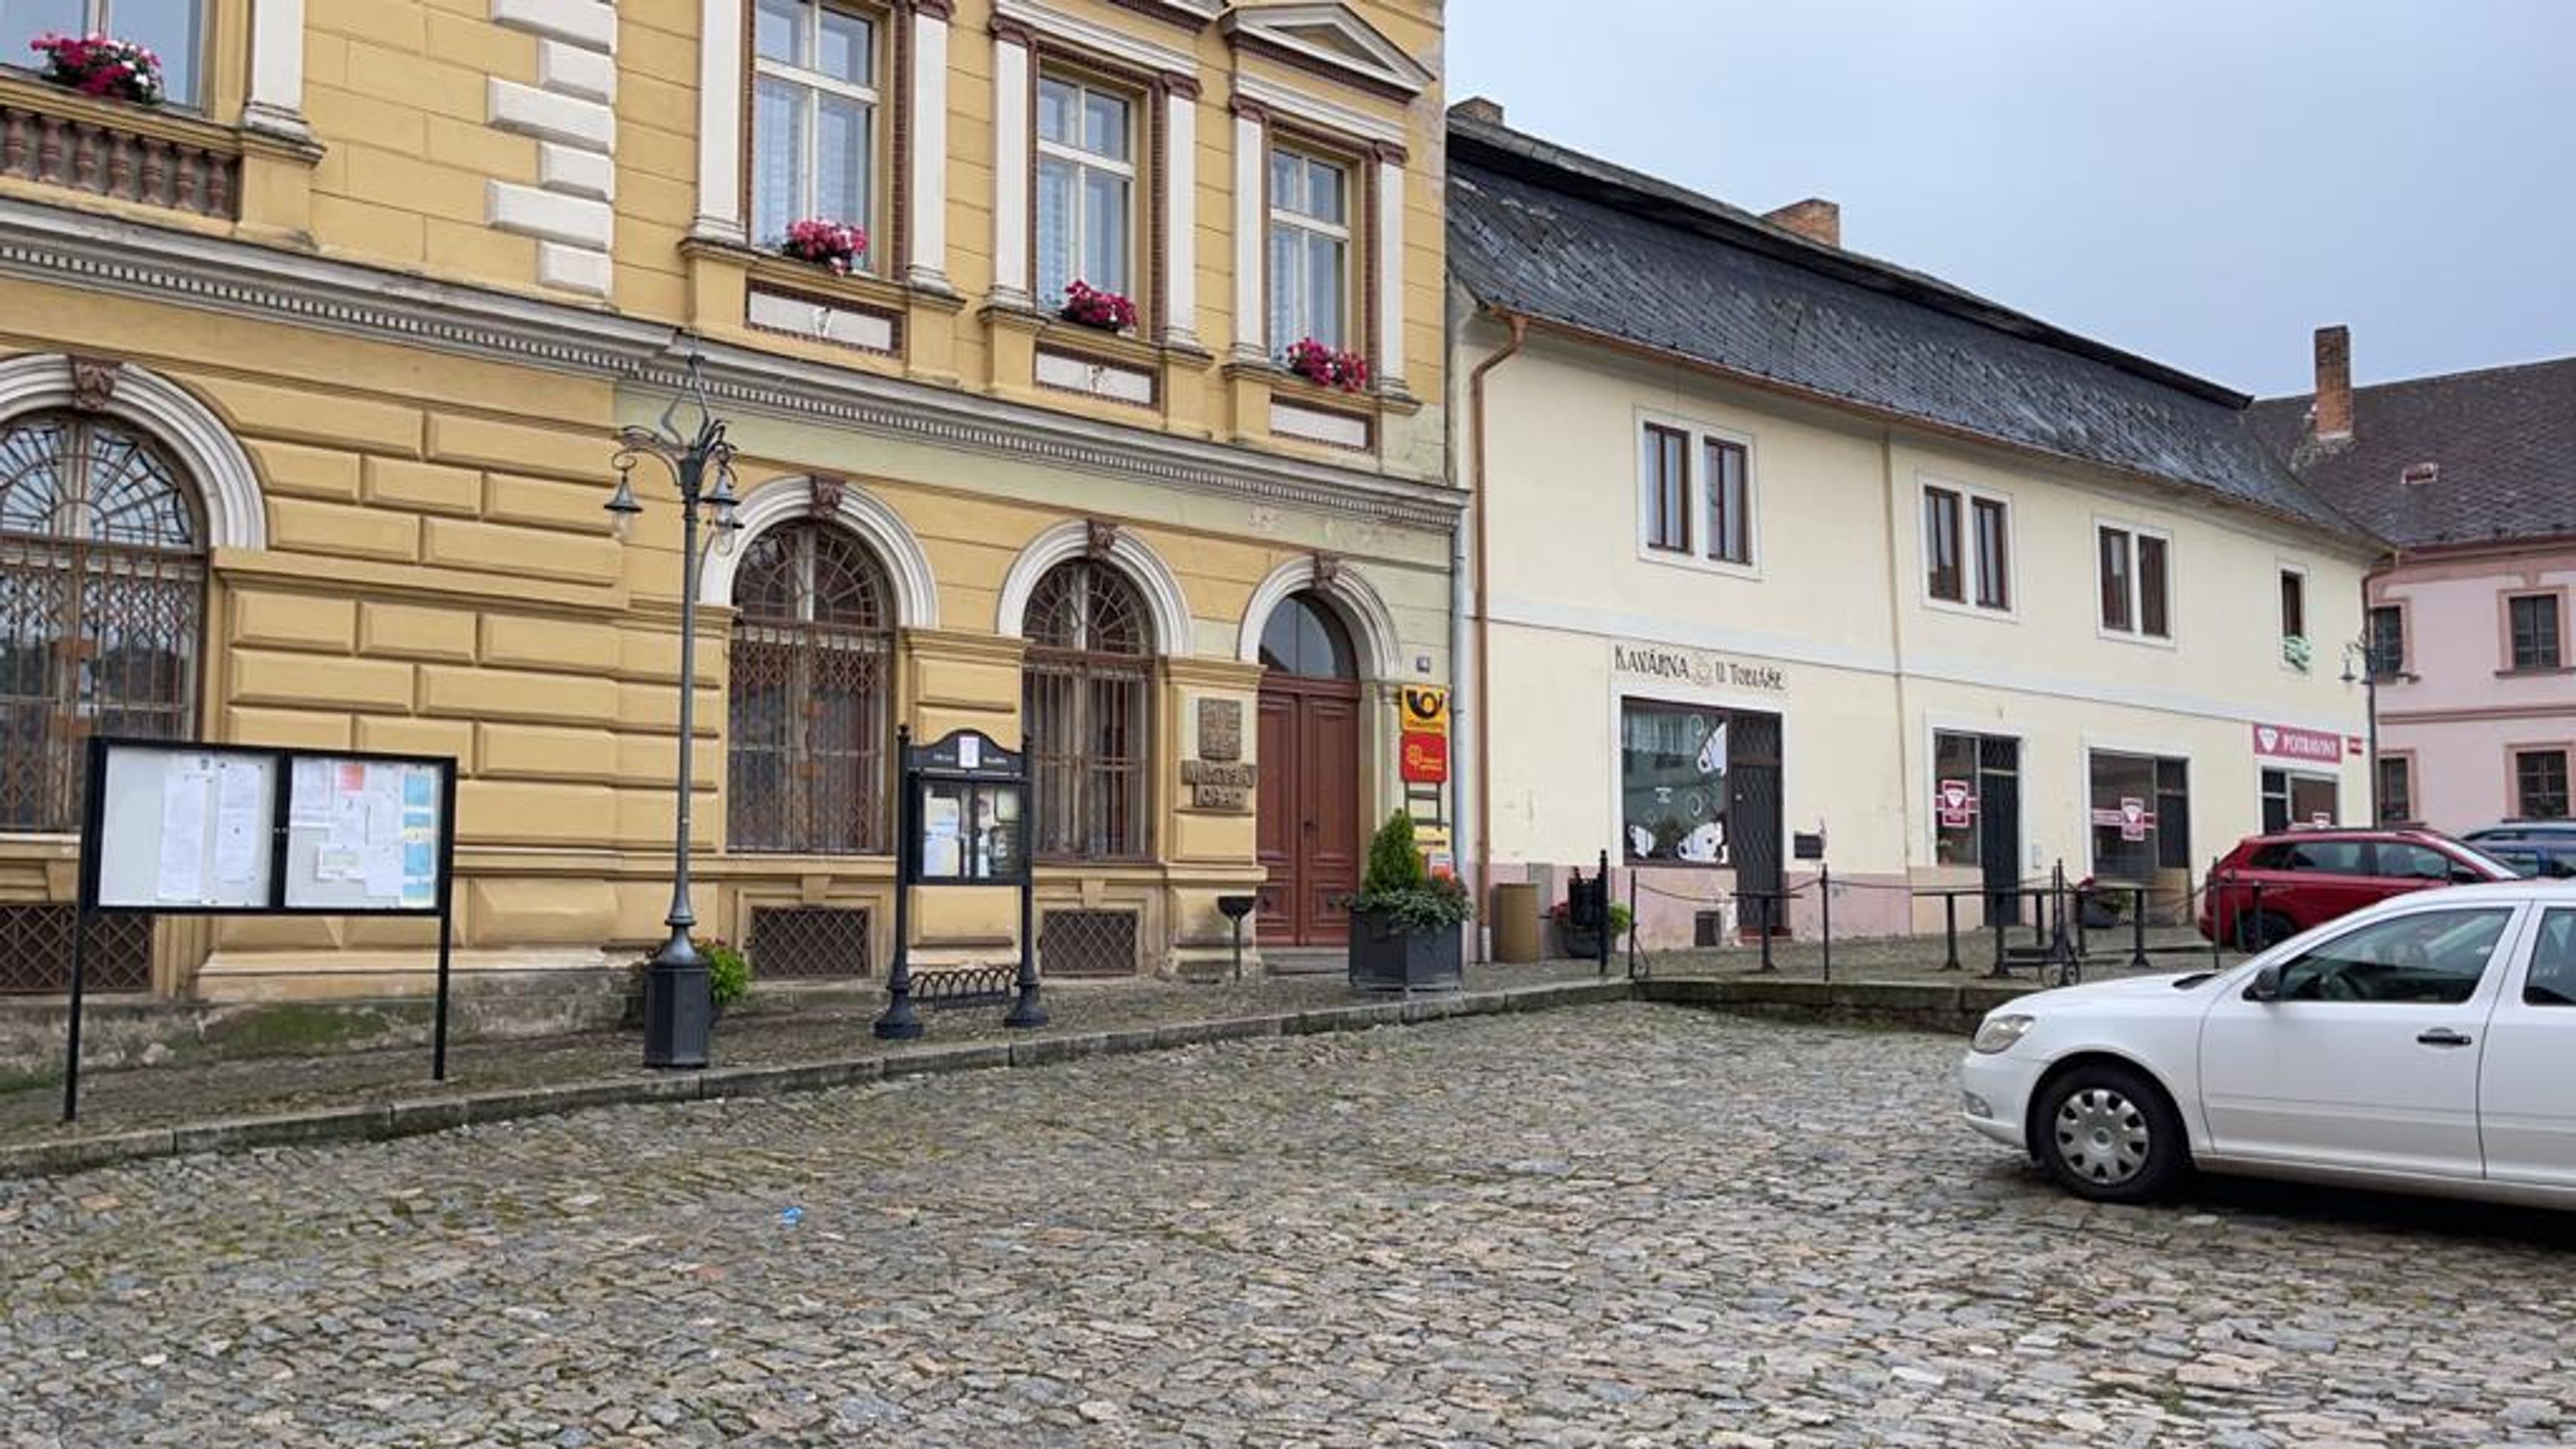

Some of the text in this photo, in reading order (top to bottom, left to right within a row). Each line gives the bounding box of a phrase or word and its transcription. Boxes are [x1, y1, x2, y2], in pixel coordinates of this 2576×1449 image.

[1614, 644, 1690, 678] KAVÁRNA
[1715, 661, 1725, 683] U
[2282, 734, 2337, 757] POTRAVINY
